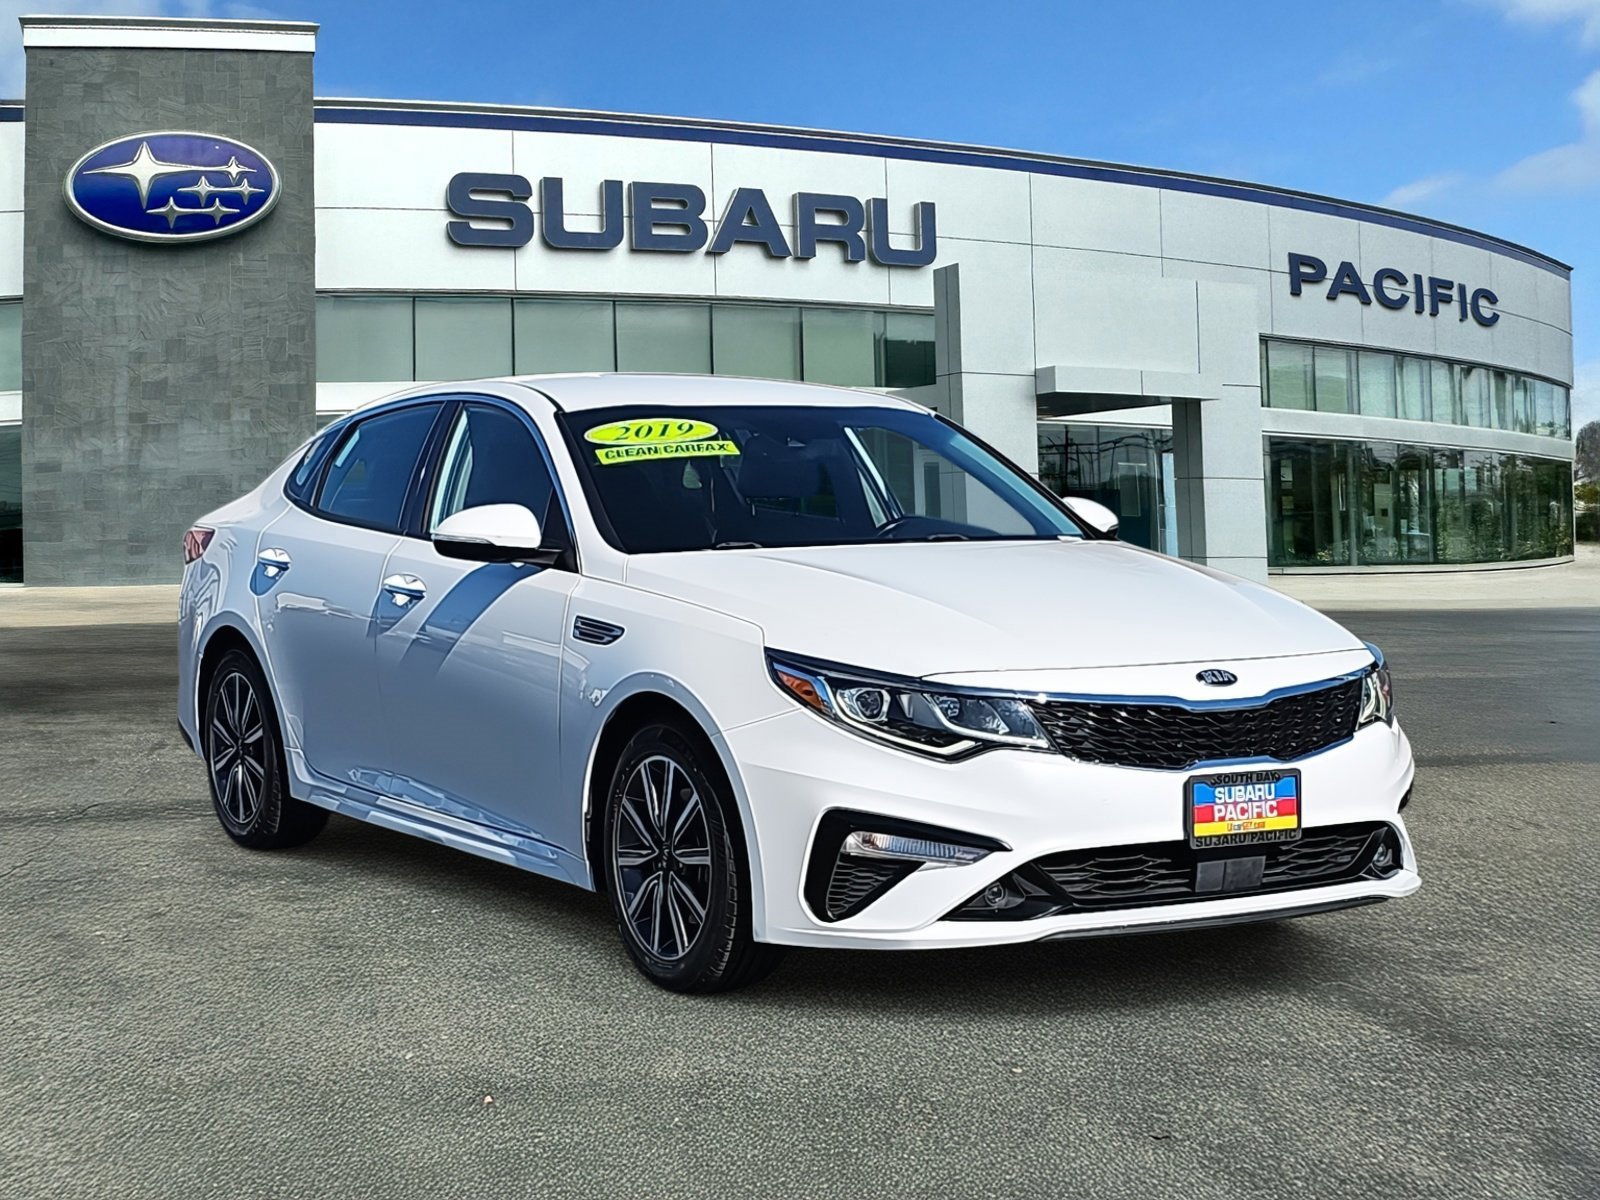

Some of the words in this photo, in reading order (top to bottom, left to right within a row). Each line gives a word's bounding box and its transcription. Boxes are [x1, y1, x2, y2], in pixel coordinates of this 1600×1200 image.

[446, 172, 937, 267] SUBARU
[1288, 252, 1500, 327] PACIFIC
[613, 422, 694, 440] 2019
[604, 445, 659, 460] CLEAN
[664, 443, 727, 454] CARFAX
[1200, 670, 1235, 683] KIA
[1216, 774, 1252, 785] SOUTH
[1256, 772, 1277, 783] BAY
[1214, 783, 1275, 803] SUBARU
[1213, 800, 1278, 821] PACIFIC
[1195, 832, 1247, 848] SUBARU
[1250, 829, 1297, 843] PACIFIC
